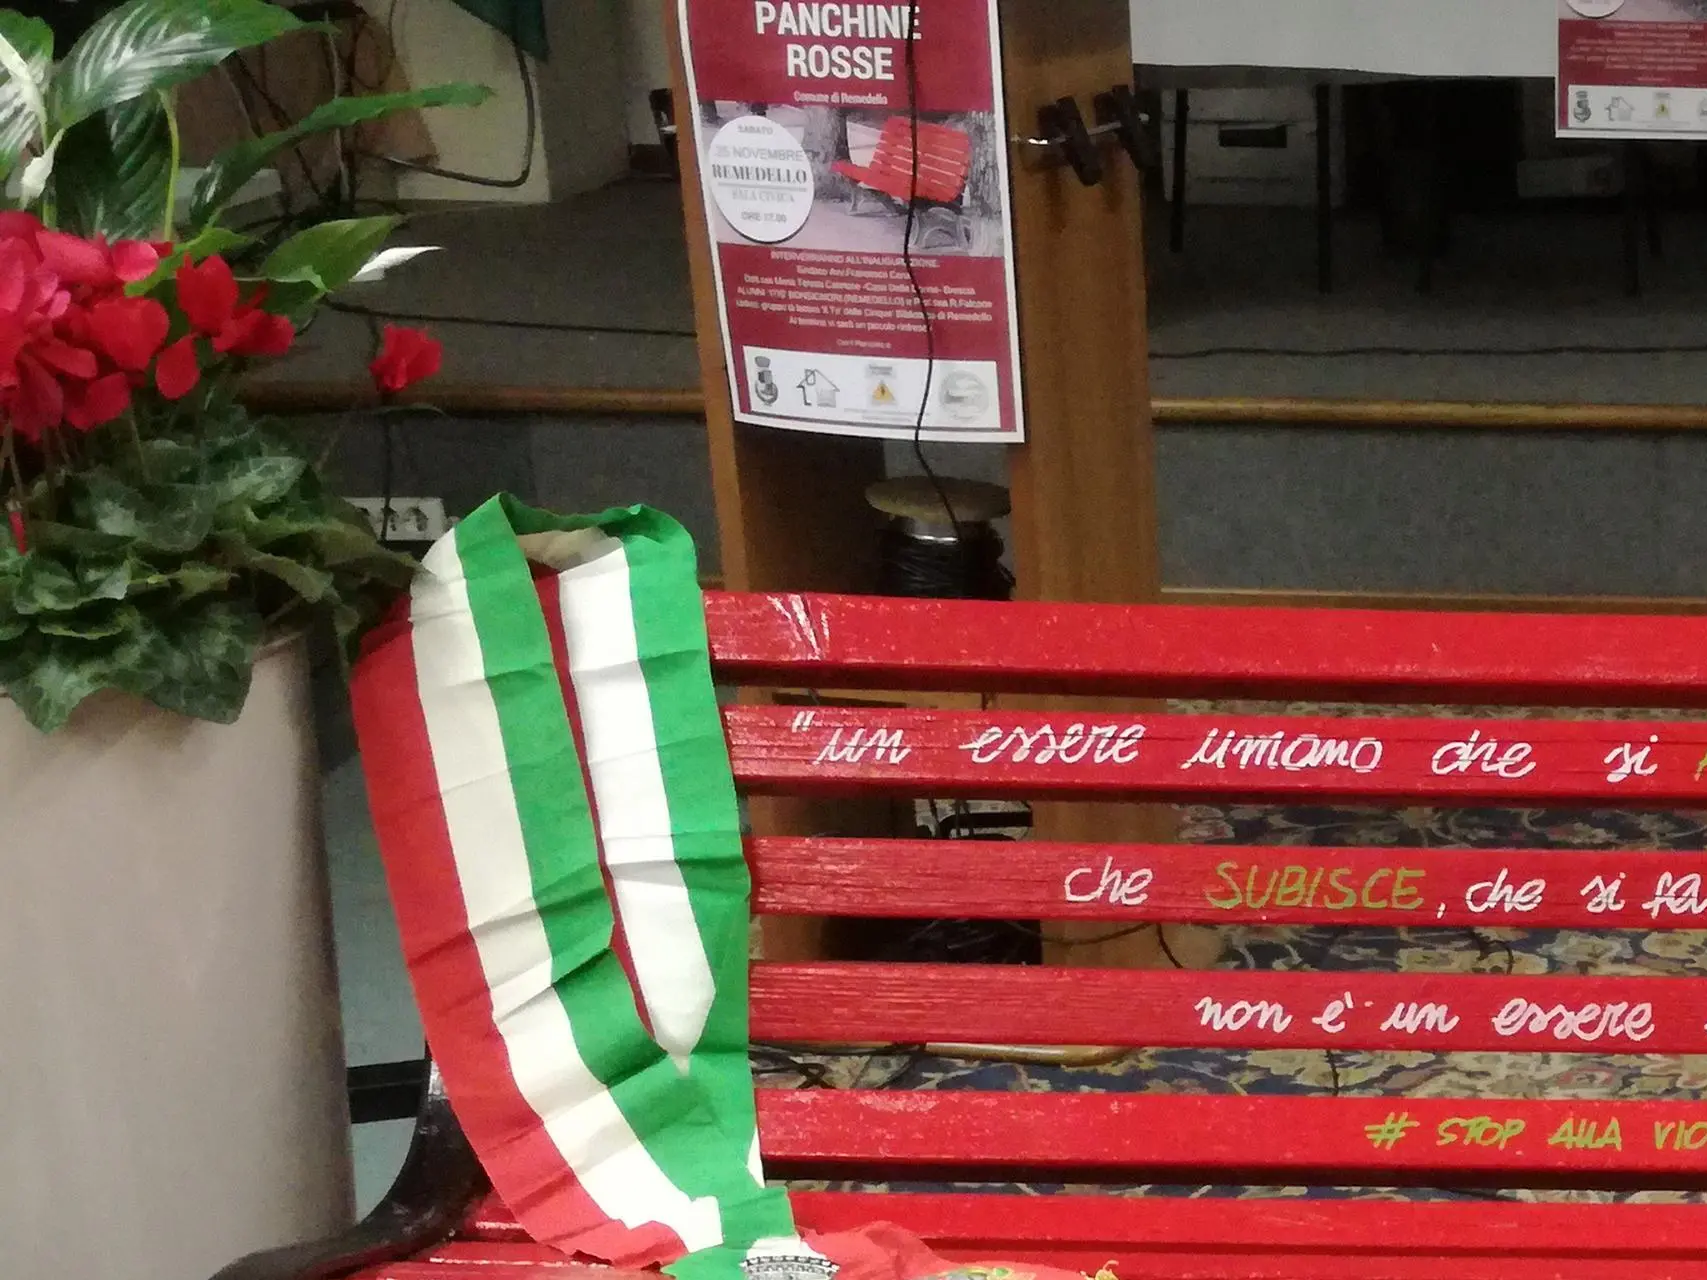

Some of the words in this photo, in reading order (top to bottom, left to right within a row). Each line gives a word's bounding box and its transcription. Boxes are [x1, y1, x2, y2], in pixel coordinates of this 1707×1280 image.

[755, 1, 922, 39] PANCHINE
[786, 44, 895, 80] ROSSE
[793, 90, 829, 103] Comune
[831, 91, 840, 103] di
[738, 124, 774, 135] SABATO
[732, 146, 805, 162] NOVEMBRE
[711, 163, 808, 184] REMEDELLO
[958, 722, 1147, 765] essere
[1180, 727, 1383, 772] umano
[1431, 729, 1537, 778] che
[1603, 734, 1659, 783] si
[1064, 856, 1153, 905] che
[1465, 868, 1547, 913] che
[1580, 872, 1626, 913] si
[1194, 996, 1293, 1033] non
[1379, 1002, 1460, 1034] un
[1491, 998, 1655, 1042] essere
[1436, 1115, 1526, 1149] STOP
[1547, 1117, 1623, 1152] ALLA
